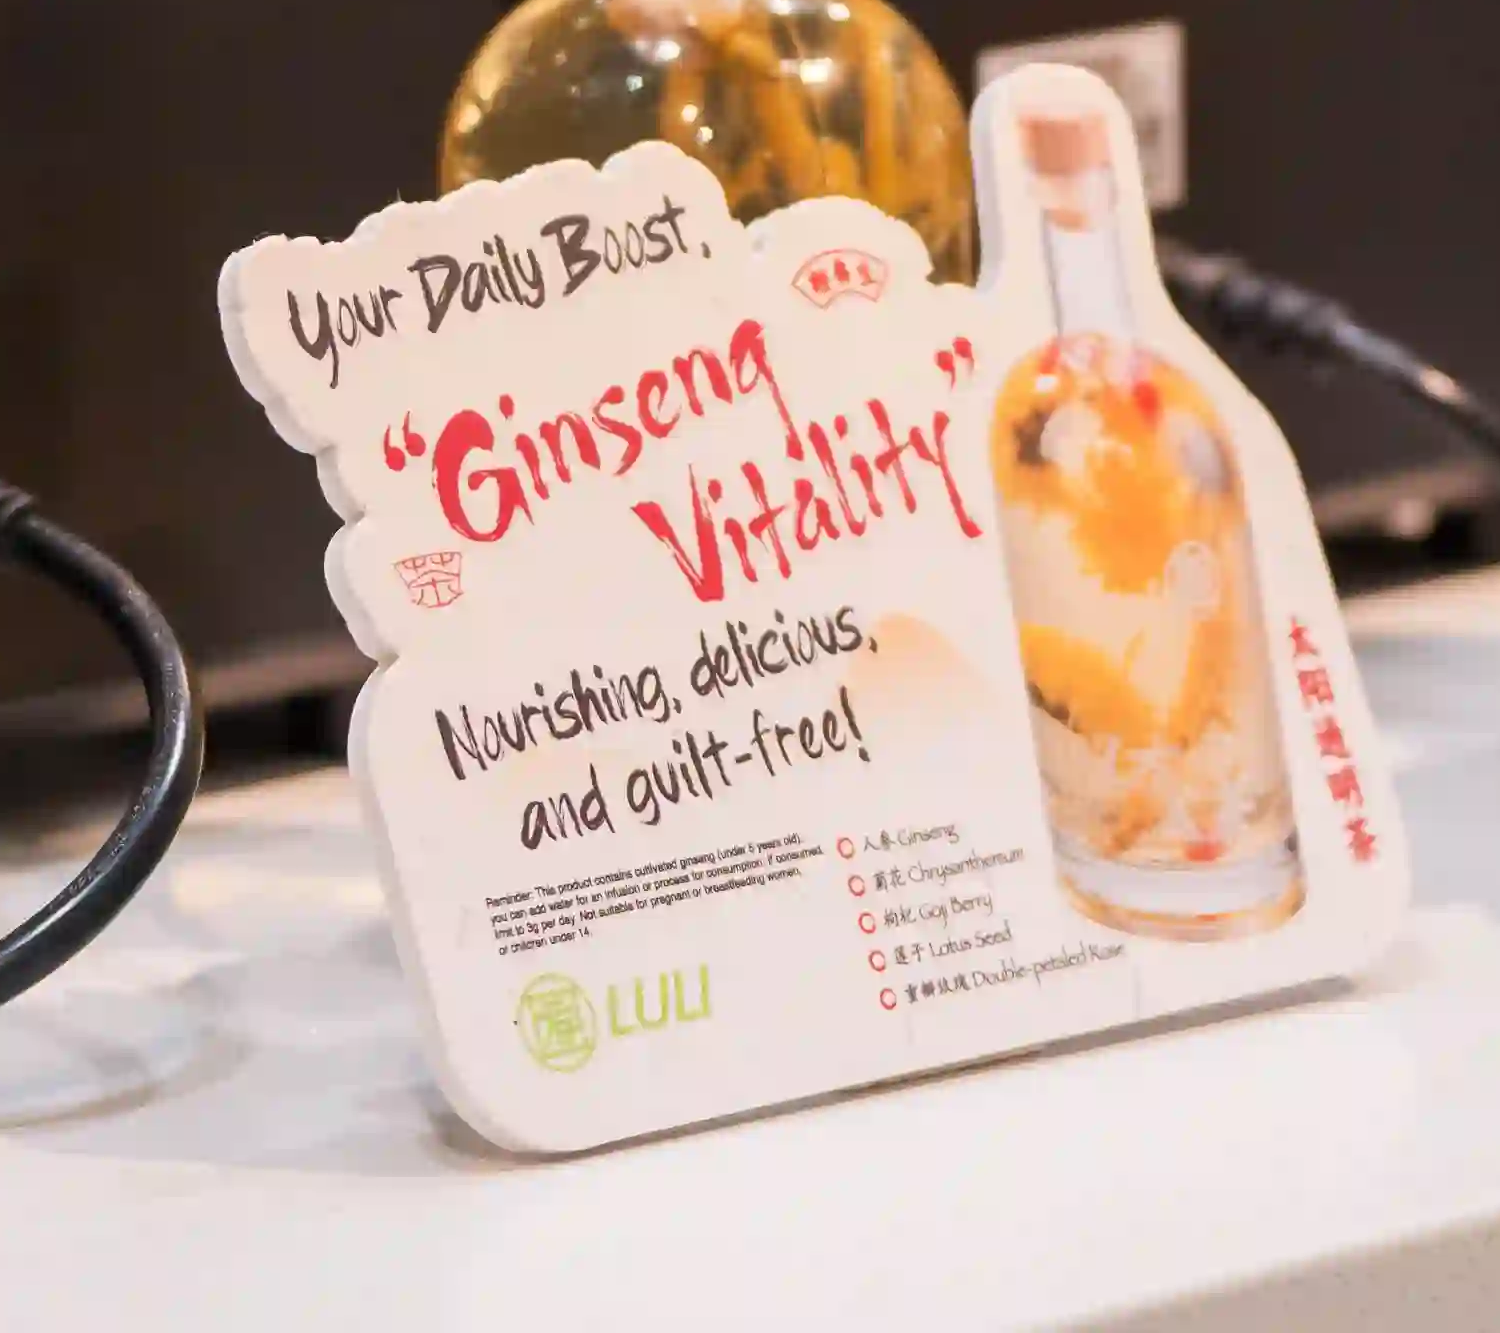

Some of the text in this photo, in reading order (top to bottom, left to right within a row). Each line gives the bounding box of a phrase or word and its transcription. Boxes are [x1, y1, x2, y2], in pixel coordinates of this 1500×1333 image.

[286, 285, 402, 390] Your
[407, 235, 545, 334] Daily
[383, 318, 804, 542] “Ginseng
[630, 336, 984, 602] Vitality”
[434, 605, 879, 780] Nourishing, delicious,
[519, 684, 871, 851] and guilt-free!
[897, 823, 960, 845] Ginseng
[490, 912, 507, 927] you
[509, 909, 527, 922] can
[529, 903, 547, 916] add
[548, 898, 574, 912] water
[575, 893, 589, 906] for
[591, 892, 604, 903] an
[605, 883, 641, 901] infusion
[654, 873, 691, 892] process
[691, 869, 705, 881] for
[534, 885, 557, 898] This
[558, 876, 593, 895] product
[594, 869, 633, 886] contains
[634, 857, 677, 879] cultivated
[680, 851, 716, 870] ginseng
[756, 838, 782, 853] years
[515, 924, 525, 935] to
[540, 917, 556, 932] per
[579, 908, 596, 921] Not
[599, 900, 635, 918] suitable
[635, 896, 648, 910] for
[649, 889, 692, 909] pregnant
[692, 887, 701, 898] or
[703, 873, 766, 895] breastfeeding
[918, 892, 994, 929] Goji Berry
[510, 936, 548, 954] children
[549, 930, 578, 945] under
[928, 918, 1012, 959] Lotus Seed
[607, 961, 711, 1038] LULI
